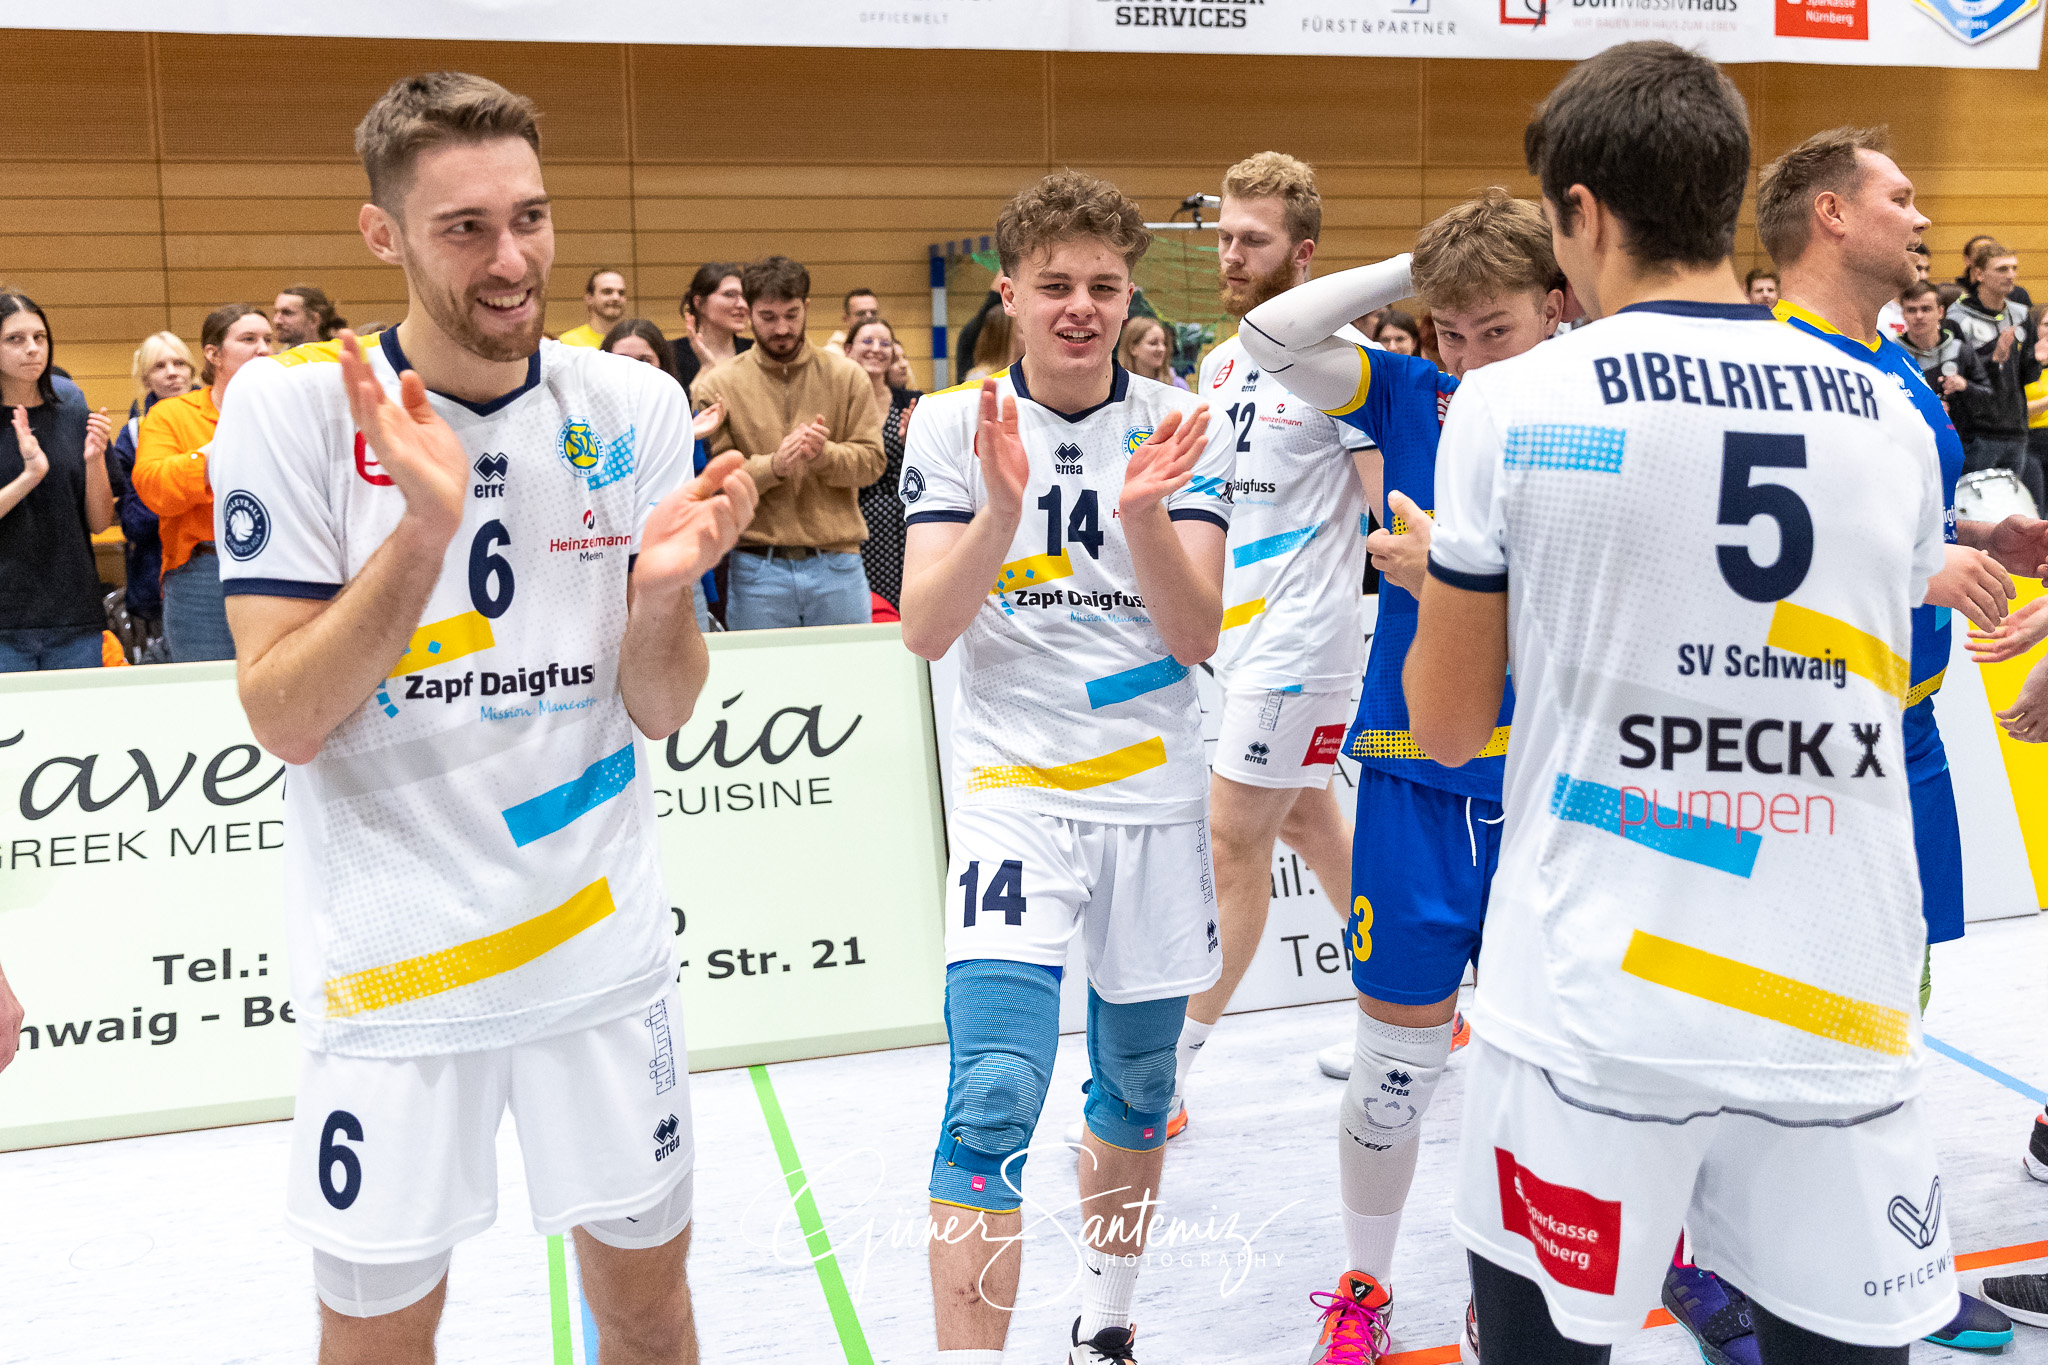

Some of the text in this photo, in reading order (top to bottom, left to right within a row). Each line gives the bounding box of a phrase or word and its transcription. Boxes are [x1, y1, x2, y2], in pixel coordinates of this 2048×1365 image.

[1116, 6, 1247, 28] SERVICES
[1806, 10, 1854, 27] Nürnberg
[1593, 352, 1879, 421] BIBELRIETHER
[473, 483, 506, 499] erre
[1054, 463, 1084, 475] errea
[1233, 478, 1276, 495] aigfuss
[1037, 484, 1104, 560] 14
[1715, 430, 1814, 603] 5
[468, 519, 515, 619] 6
[1014, 589, 1064, 609] Zapf
[405, 662, 596, 704] Zapf Daigfus
[1677, 643, 1847, 689] SV Schwaig
[480, 705, 533, 723] Mission
[1244, 753, 1268, 766] errea
[1618, 713, 1835, 778] SPECK
[0, 729, 286, 821] ave
[0, 776, 833, 870] REEK MED CUISINE
[1619, 786, 1835, 844] pumpen
[959, 859, 1027, 928] 14
[153, 947, 269, 986] Tel.:
[1280, 928, 1352, 977] Tel
[244, 996, 297, 1028] Be
[707, 948, 791, 979] Str.
[811, 936, 866, 969] 21
[1380, 1082, 1411, 1097] errea
[318, 1109, 364, 1210] 6
[654, 1134, 681, 1162] errea
[1525, 1198, 1599, 1243] Sparkasse
[1528, 1218, 1591, 1270] Nürnberg
[1863, 1247, 1952, 1297] OFFICEWE
